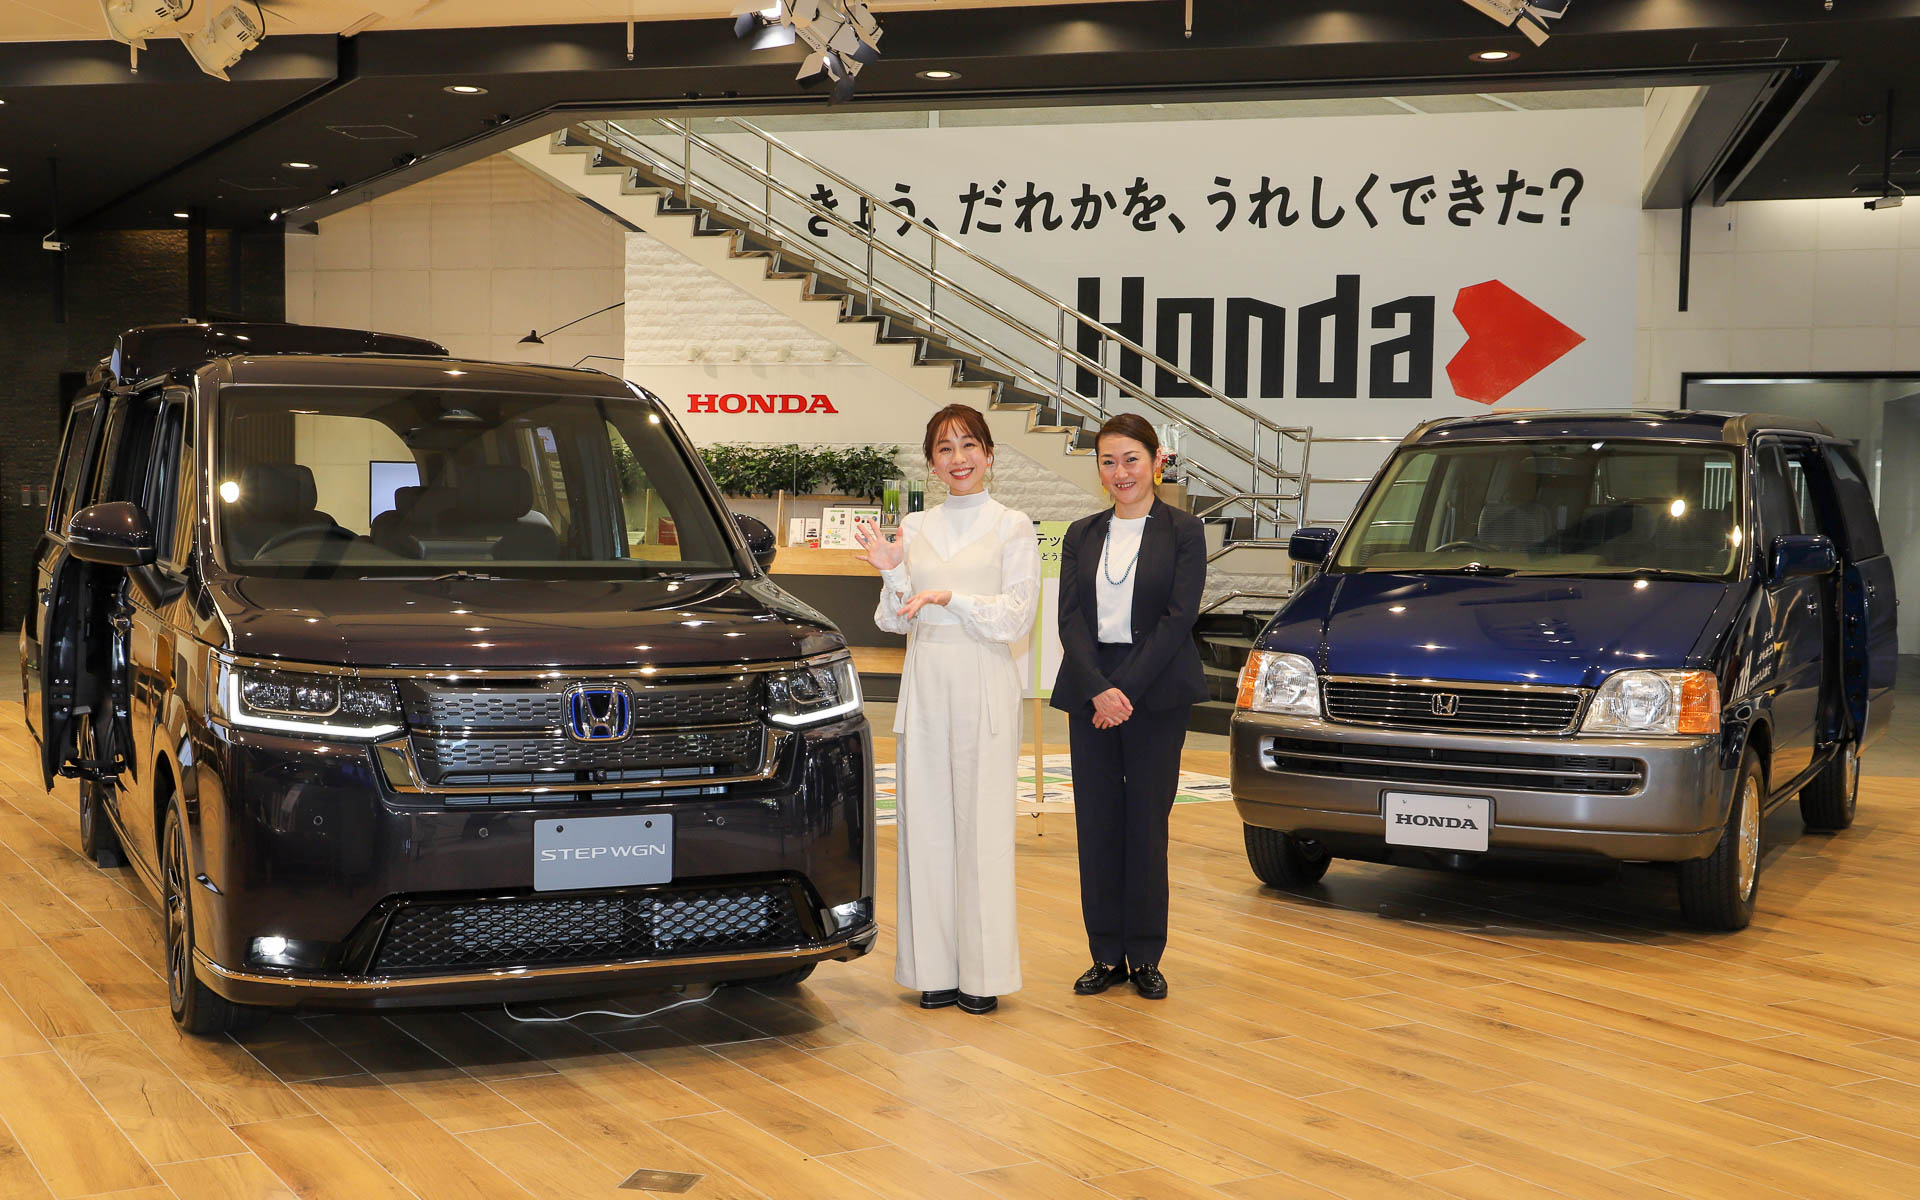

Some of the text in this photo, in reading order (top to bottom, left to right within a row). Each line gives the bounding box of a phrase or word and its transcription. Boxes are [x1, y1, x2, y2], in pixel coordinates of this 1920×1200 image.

[1076, 274, 1436, 399] Honda
[687, 393, 839, 414] HONDA
[1395, 813, 1479, 830] HONDA
